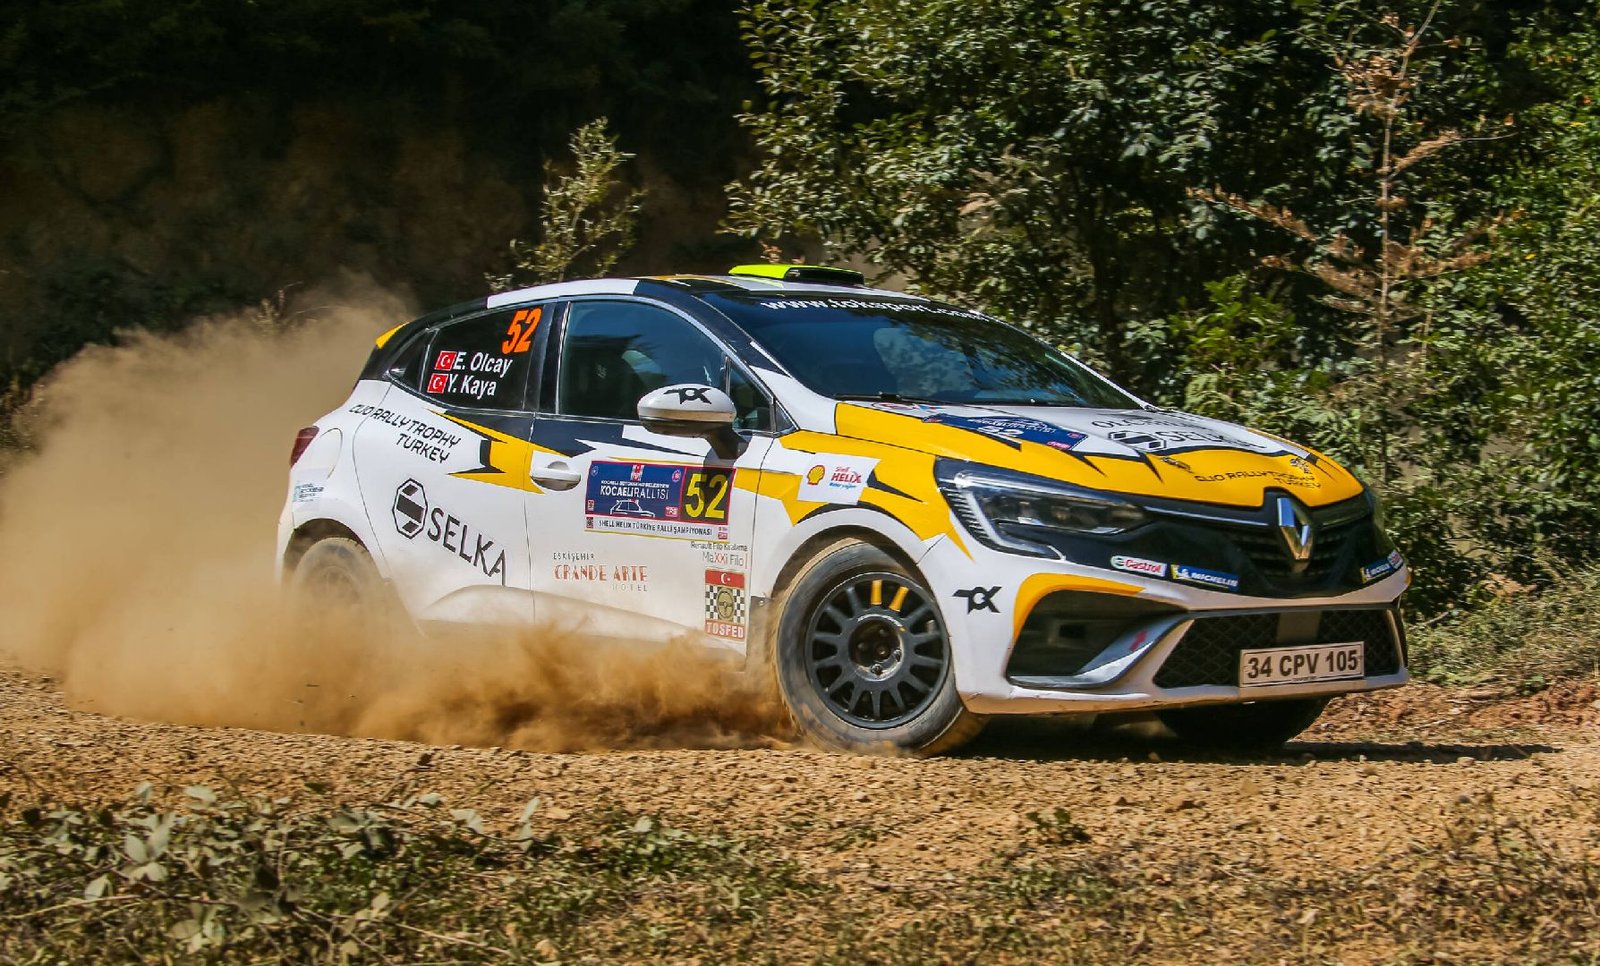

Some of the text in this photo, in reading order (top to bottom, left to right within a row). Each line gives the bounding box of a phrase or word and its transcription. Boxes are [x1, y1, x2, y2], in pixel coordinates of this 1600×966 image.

[502, 308, 542, 355] 52
[454, 351, 513, 378] E. Olcay
[446, 374, 497, 399] Y. Kaya
[396, 433, 450, 464] TURKEY
[831, 473, 862, 484] HELIX
[685, 472, 728, 519] 52
[427, 507, 506, 587] SELKA
[554, 564, 648, 582] GRANDE ARTE
[1125, 559, 1161, 573] Castrol
[612, 584, 648, 592] HOTEL
[1191, 571, 1239, 587] MICHELIN
[705, 621, 744, 639] TOSFED
[1247, 650, 1358, 678] 34 CPV 105
